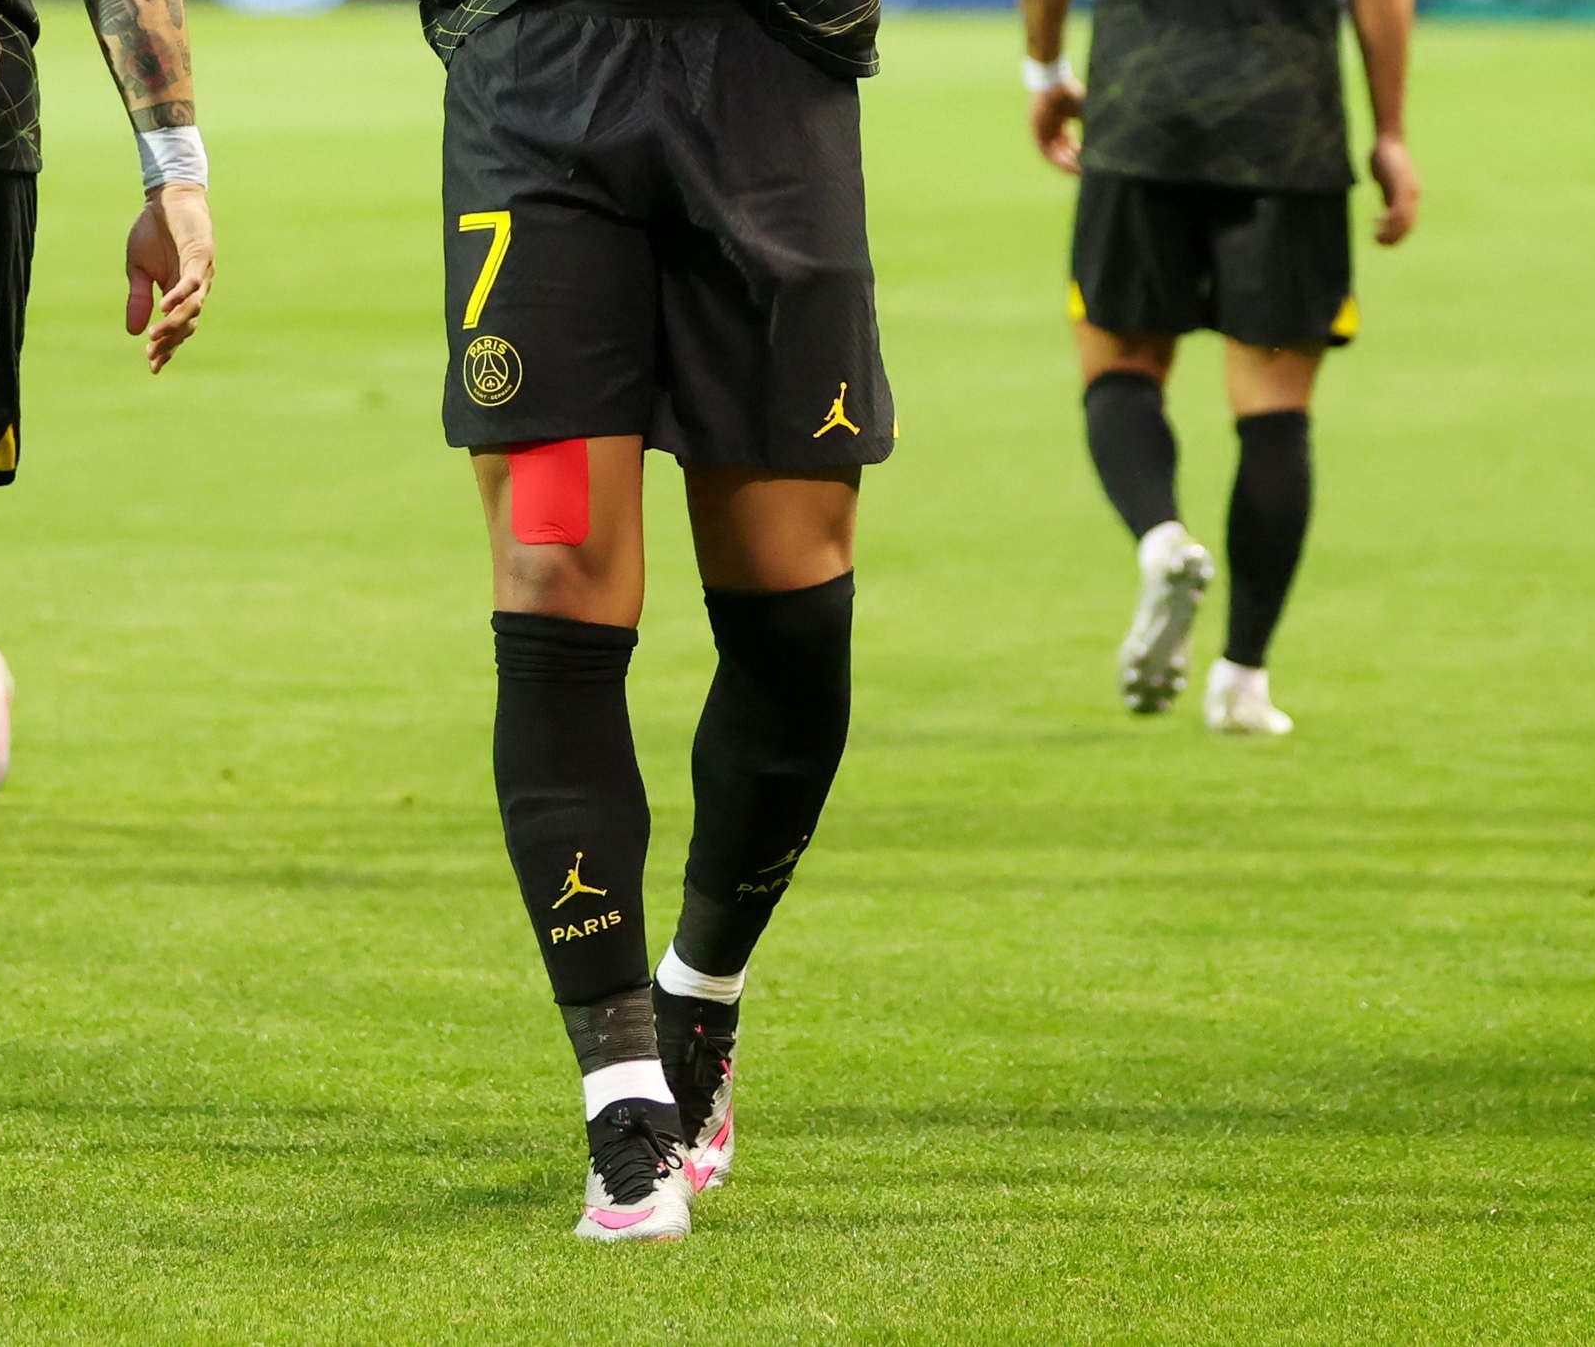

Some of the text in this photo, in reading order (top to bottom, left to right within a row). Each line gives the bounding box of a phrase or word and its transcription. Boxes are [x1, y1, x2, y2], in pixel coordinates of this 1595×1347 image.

[459, 210, 512, 330] 7
[468, 339, 508, 358] PARIS
[550, 908, 623, 946] PARIS
